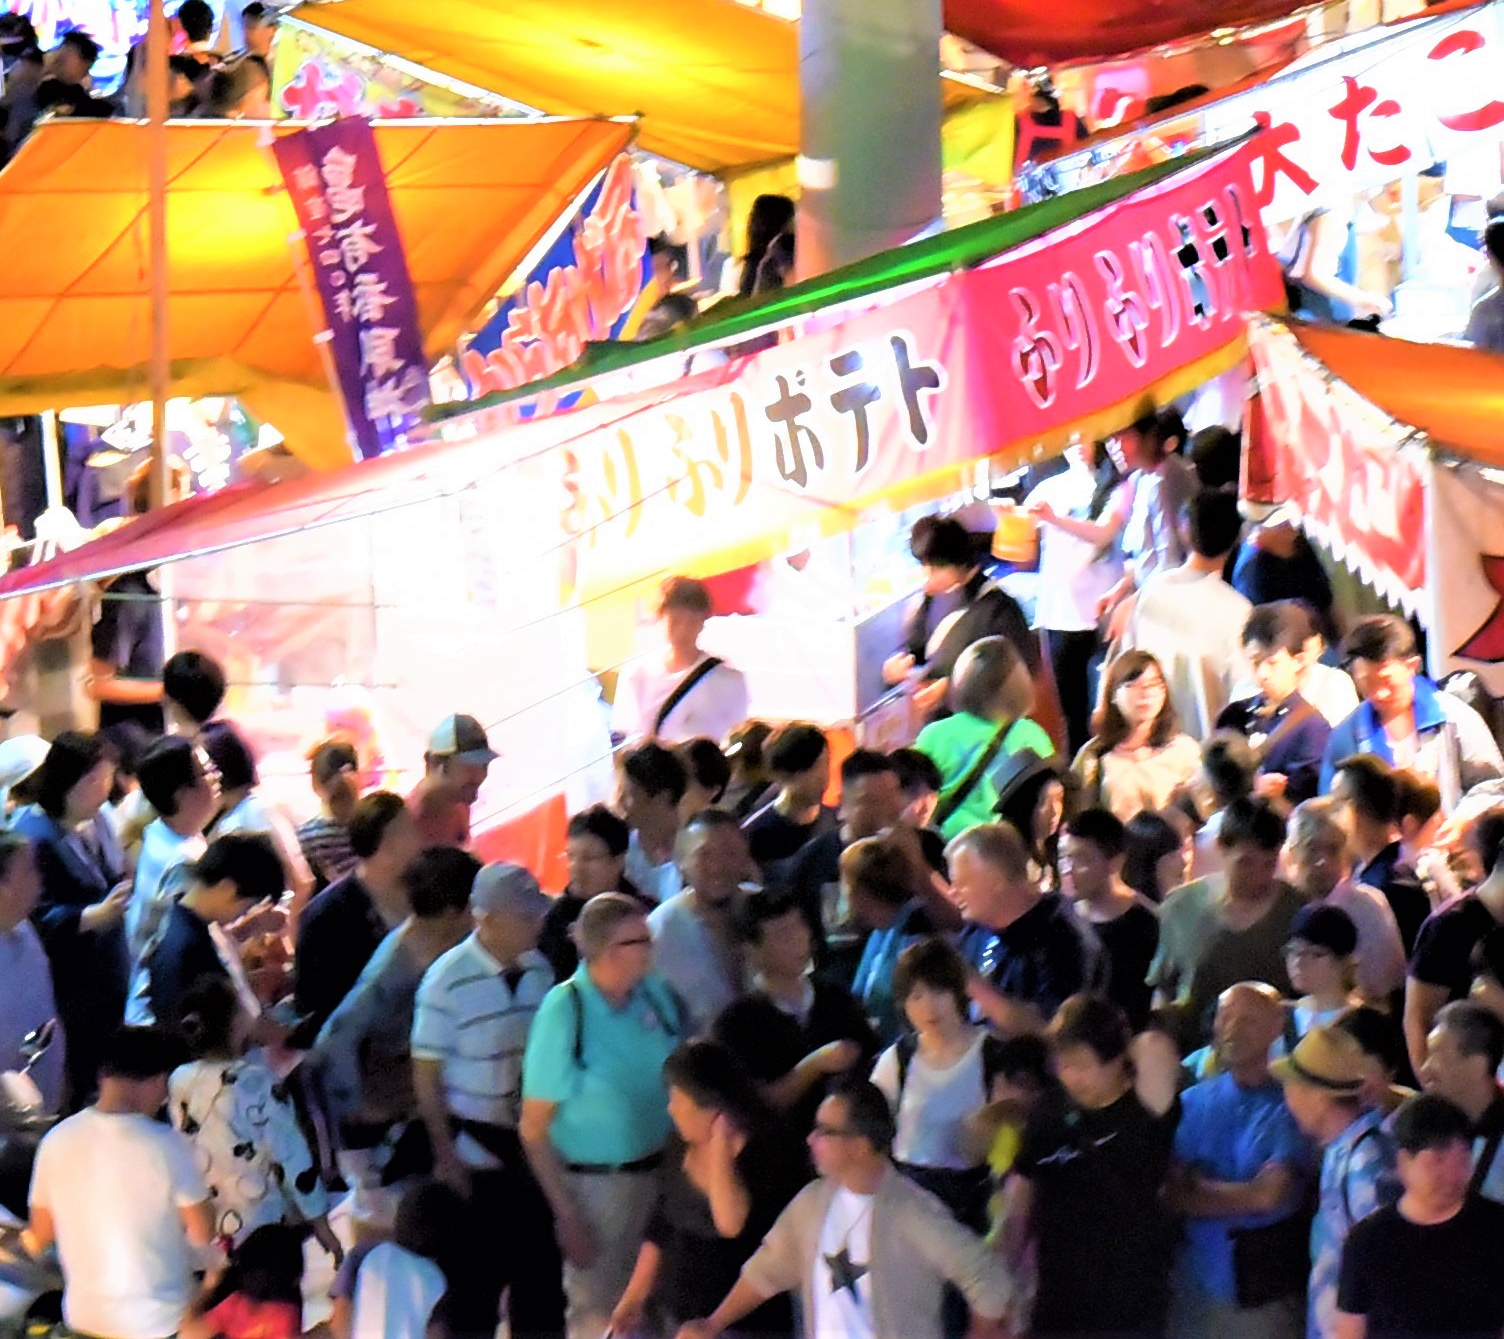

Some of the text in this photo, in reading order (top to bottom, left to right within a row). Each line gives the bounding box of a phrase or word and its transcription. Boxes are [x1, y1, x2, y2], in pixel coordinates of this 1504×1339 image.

[1007, 182, 1258, 410] ふりふりポテト
